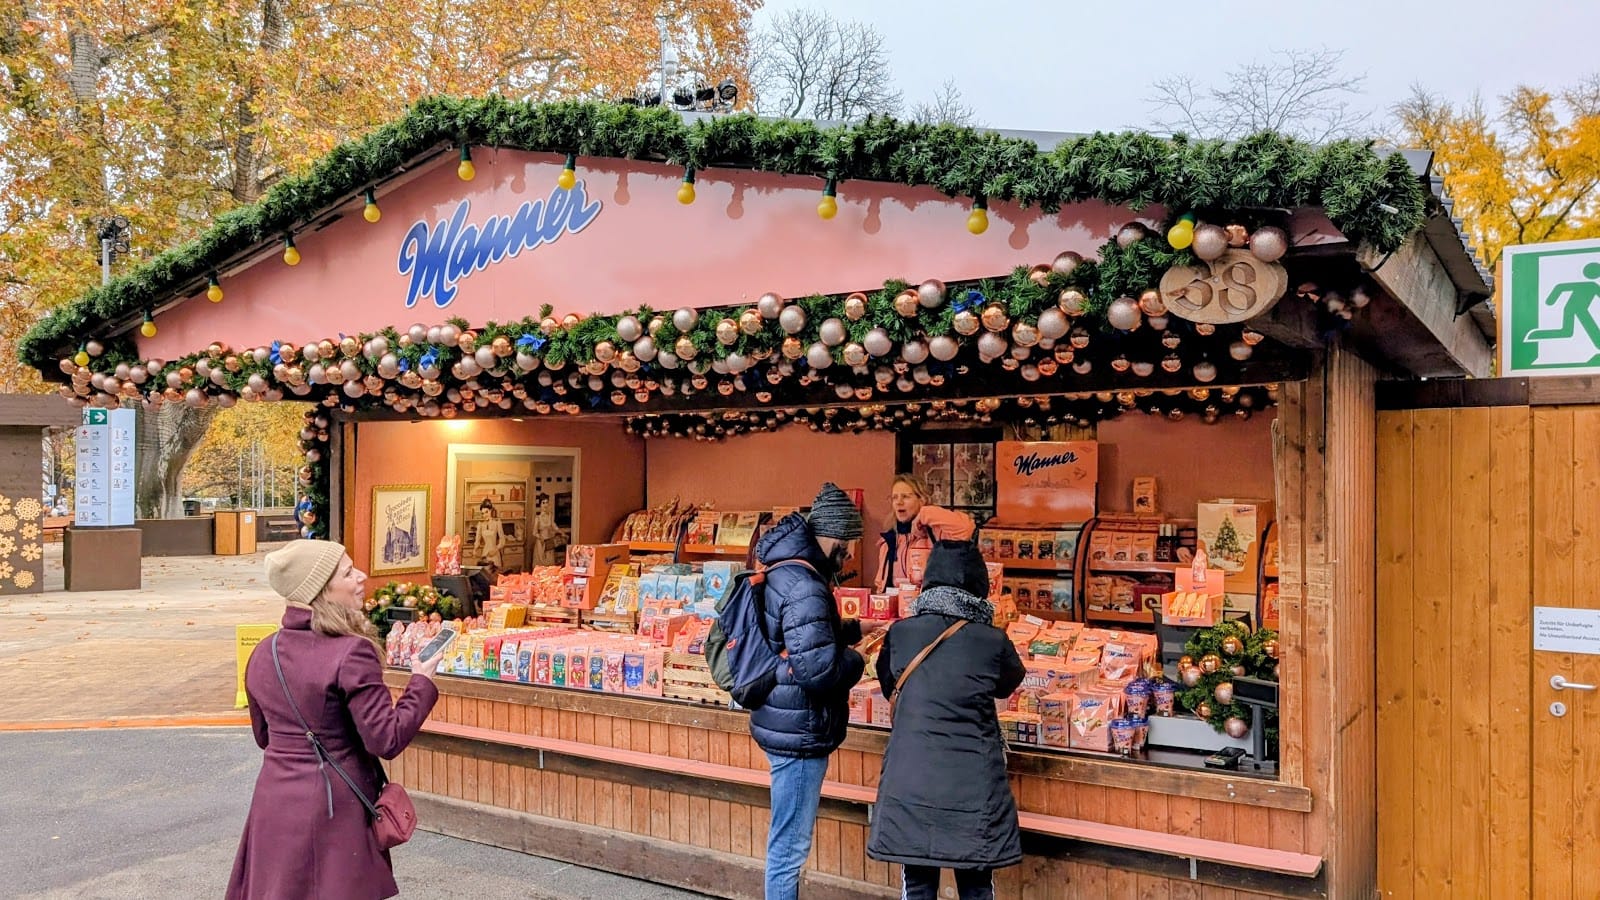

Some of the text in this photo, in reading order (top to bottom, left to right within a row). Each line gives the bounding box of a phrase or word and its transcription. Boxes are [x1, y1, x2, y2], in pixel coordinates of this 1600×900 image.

[398, 179, 603, 308] Manner
[1013, 451, 1079, 476] Manner
[1021, 676, 1050, 688] AMILY
